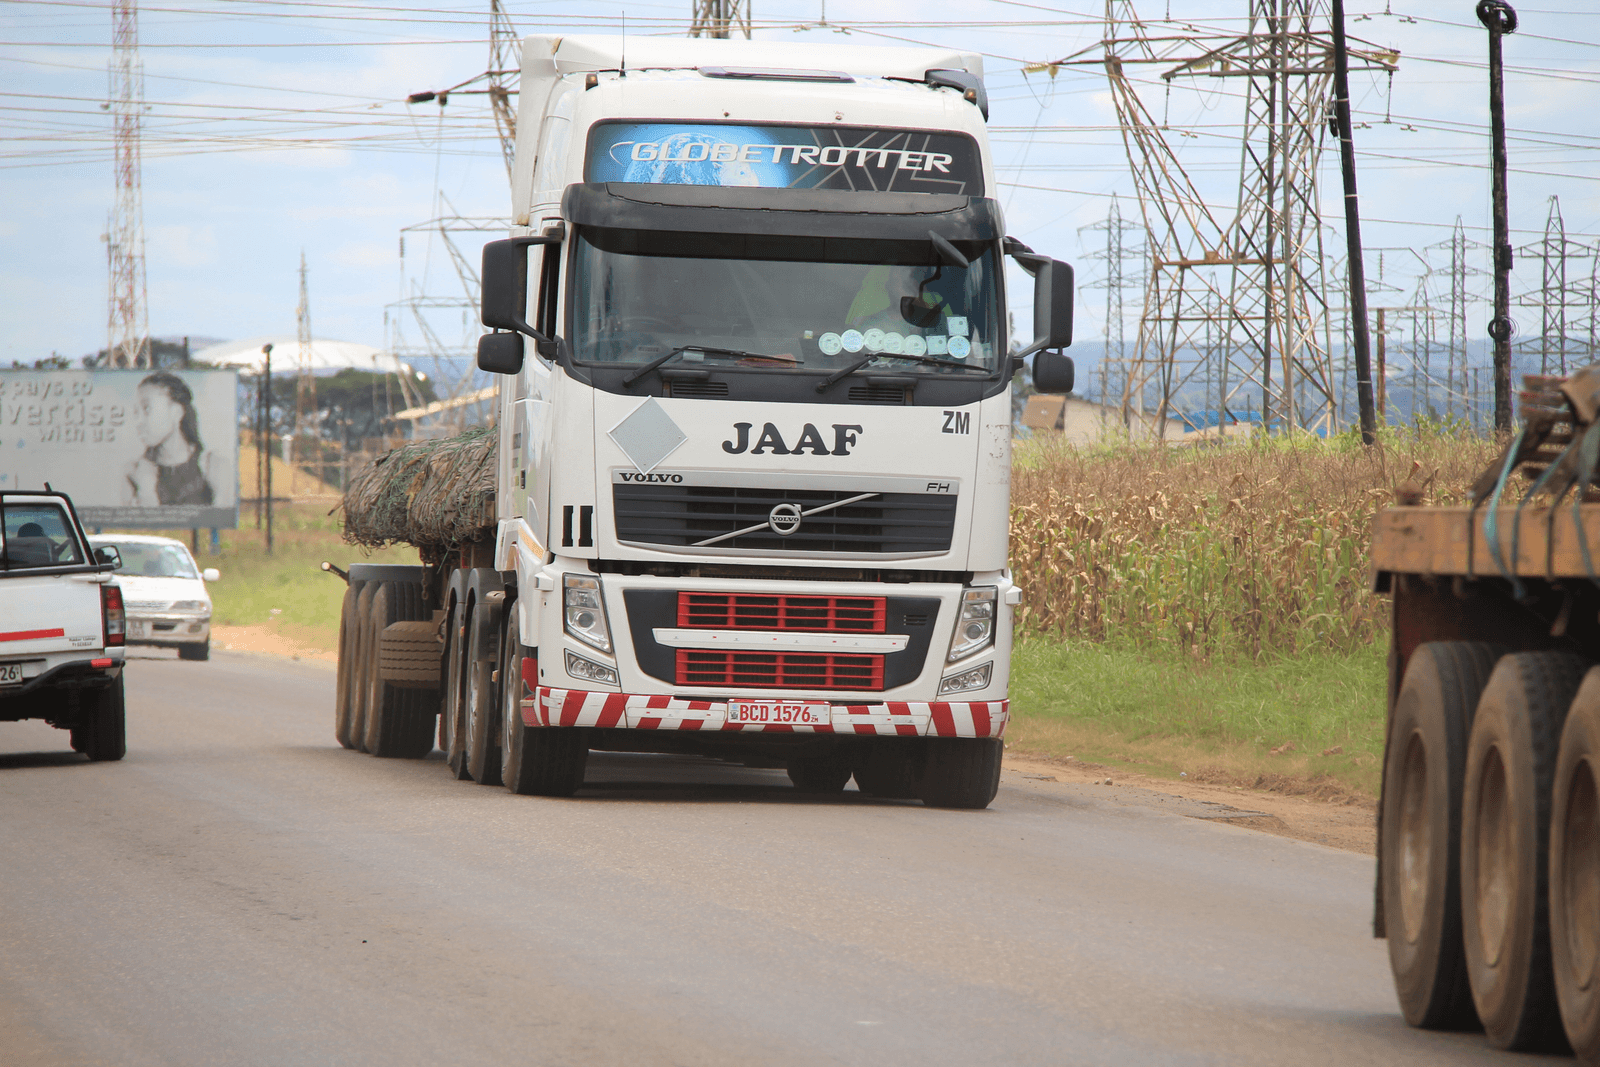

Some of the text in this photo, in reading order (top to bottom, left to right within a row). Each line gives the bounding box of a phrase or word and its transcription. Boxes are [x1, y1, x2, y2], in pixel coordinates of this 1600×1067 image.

[630, 141, 953, 173] GLOBETROTTER
[0, 399, 125, 426] vertise
[941, 410, 970, 435] ZM
[721, 422, 863, 456] JAAF
[619, 472, 683, 483] VOLVO
[926, 482, 950, 492] FH
[740, 704, 810, 722] BCD 1576
